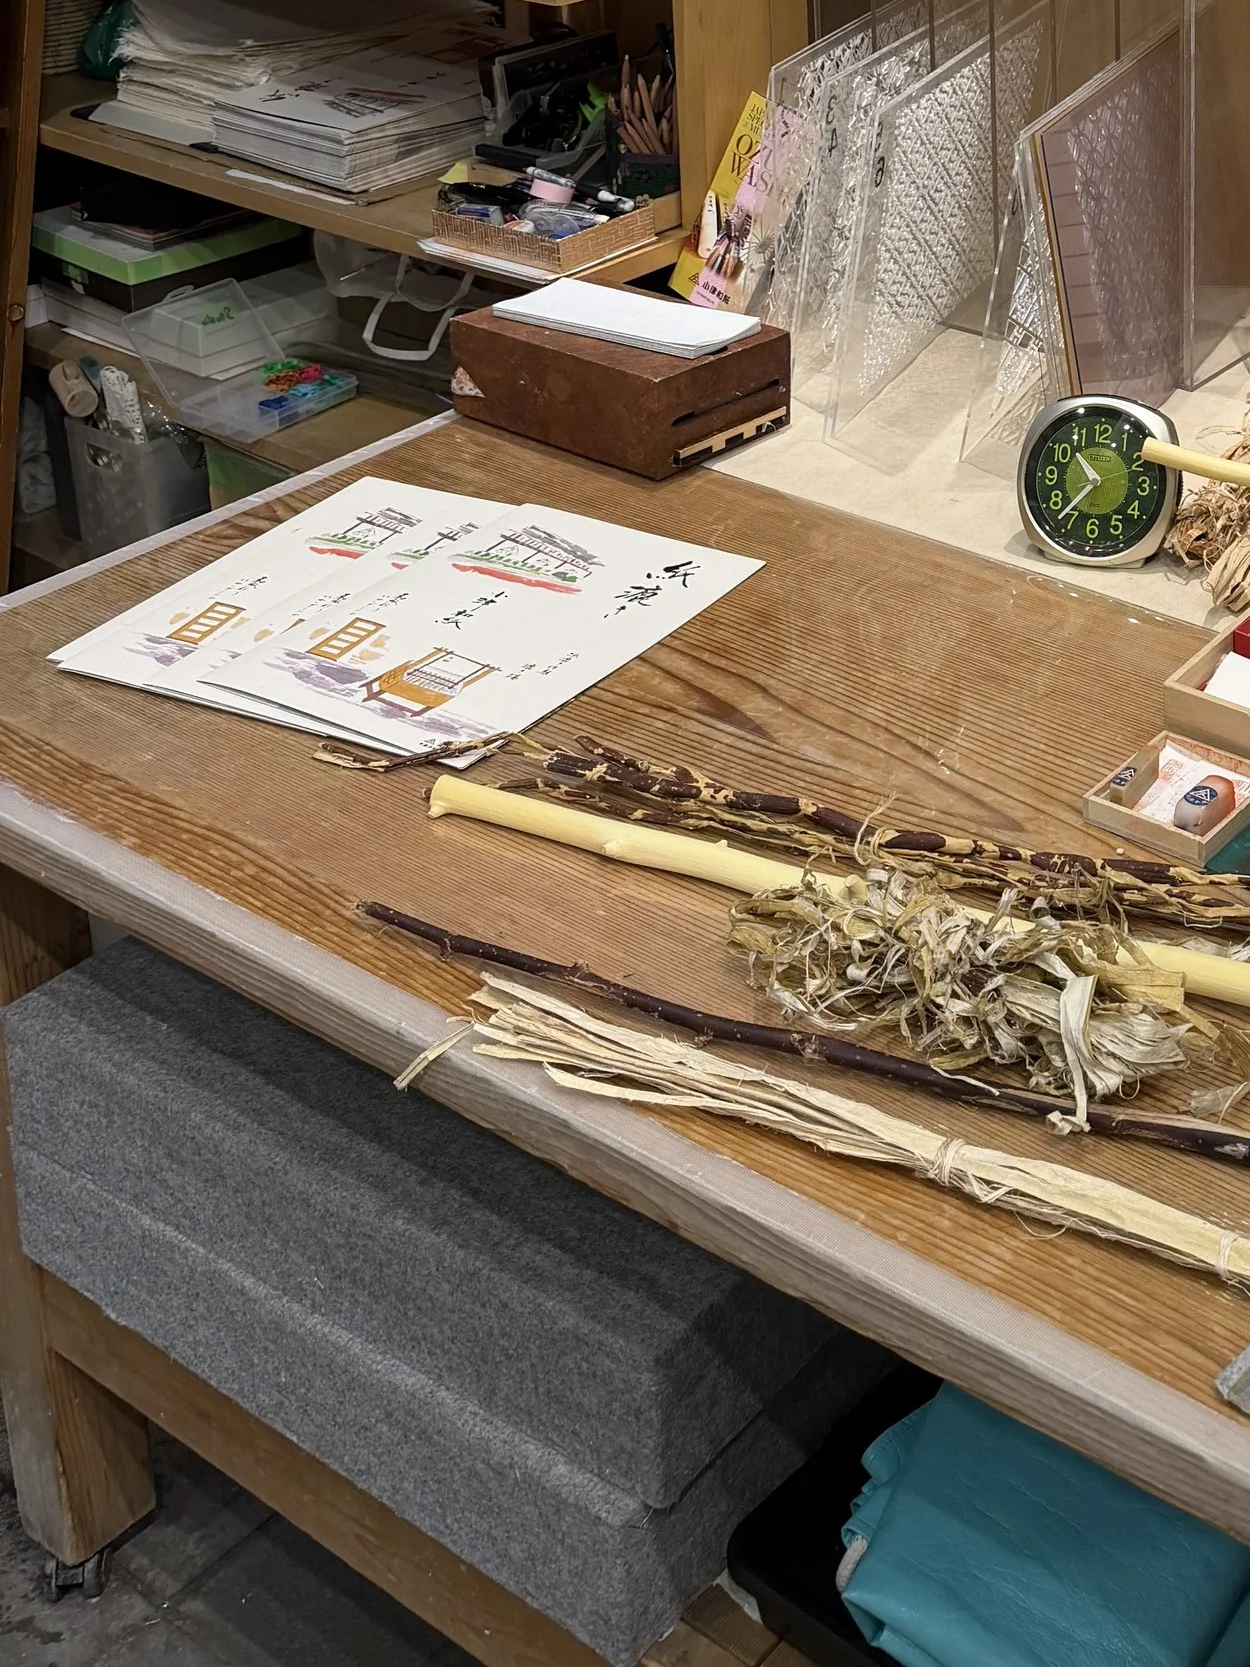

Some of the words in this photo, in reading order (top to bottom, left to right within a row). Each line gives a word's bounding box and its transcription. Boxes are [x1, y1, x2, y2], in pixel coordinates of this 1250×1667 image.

[1073, 427, 1087, 446] 11
[1094, 424, 1113, 444] 12
[1121, 432, 1128, 452] 1
[1053, 442, 1071, 463] 10
[1131, 452, 1144, 471] 2
[1045, 465, 1058, 485] 9
[1137, 476, 1150, 496] 3
[1050, 490, 1063, 510] 8
[1127, 499, 1140, 519] 4
[1067, 510, 1079, 530] 7
[1086, 519, 1099, 539] 6
[1110, 515, 1123, 535] 5
